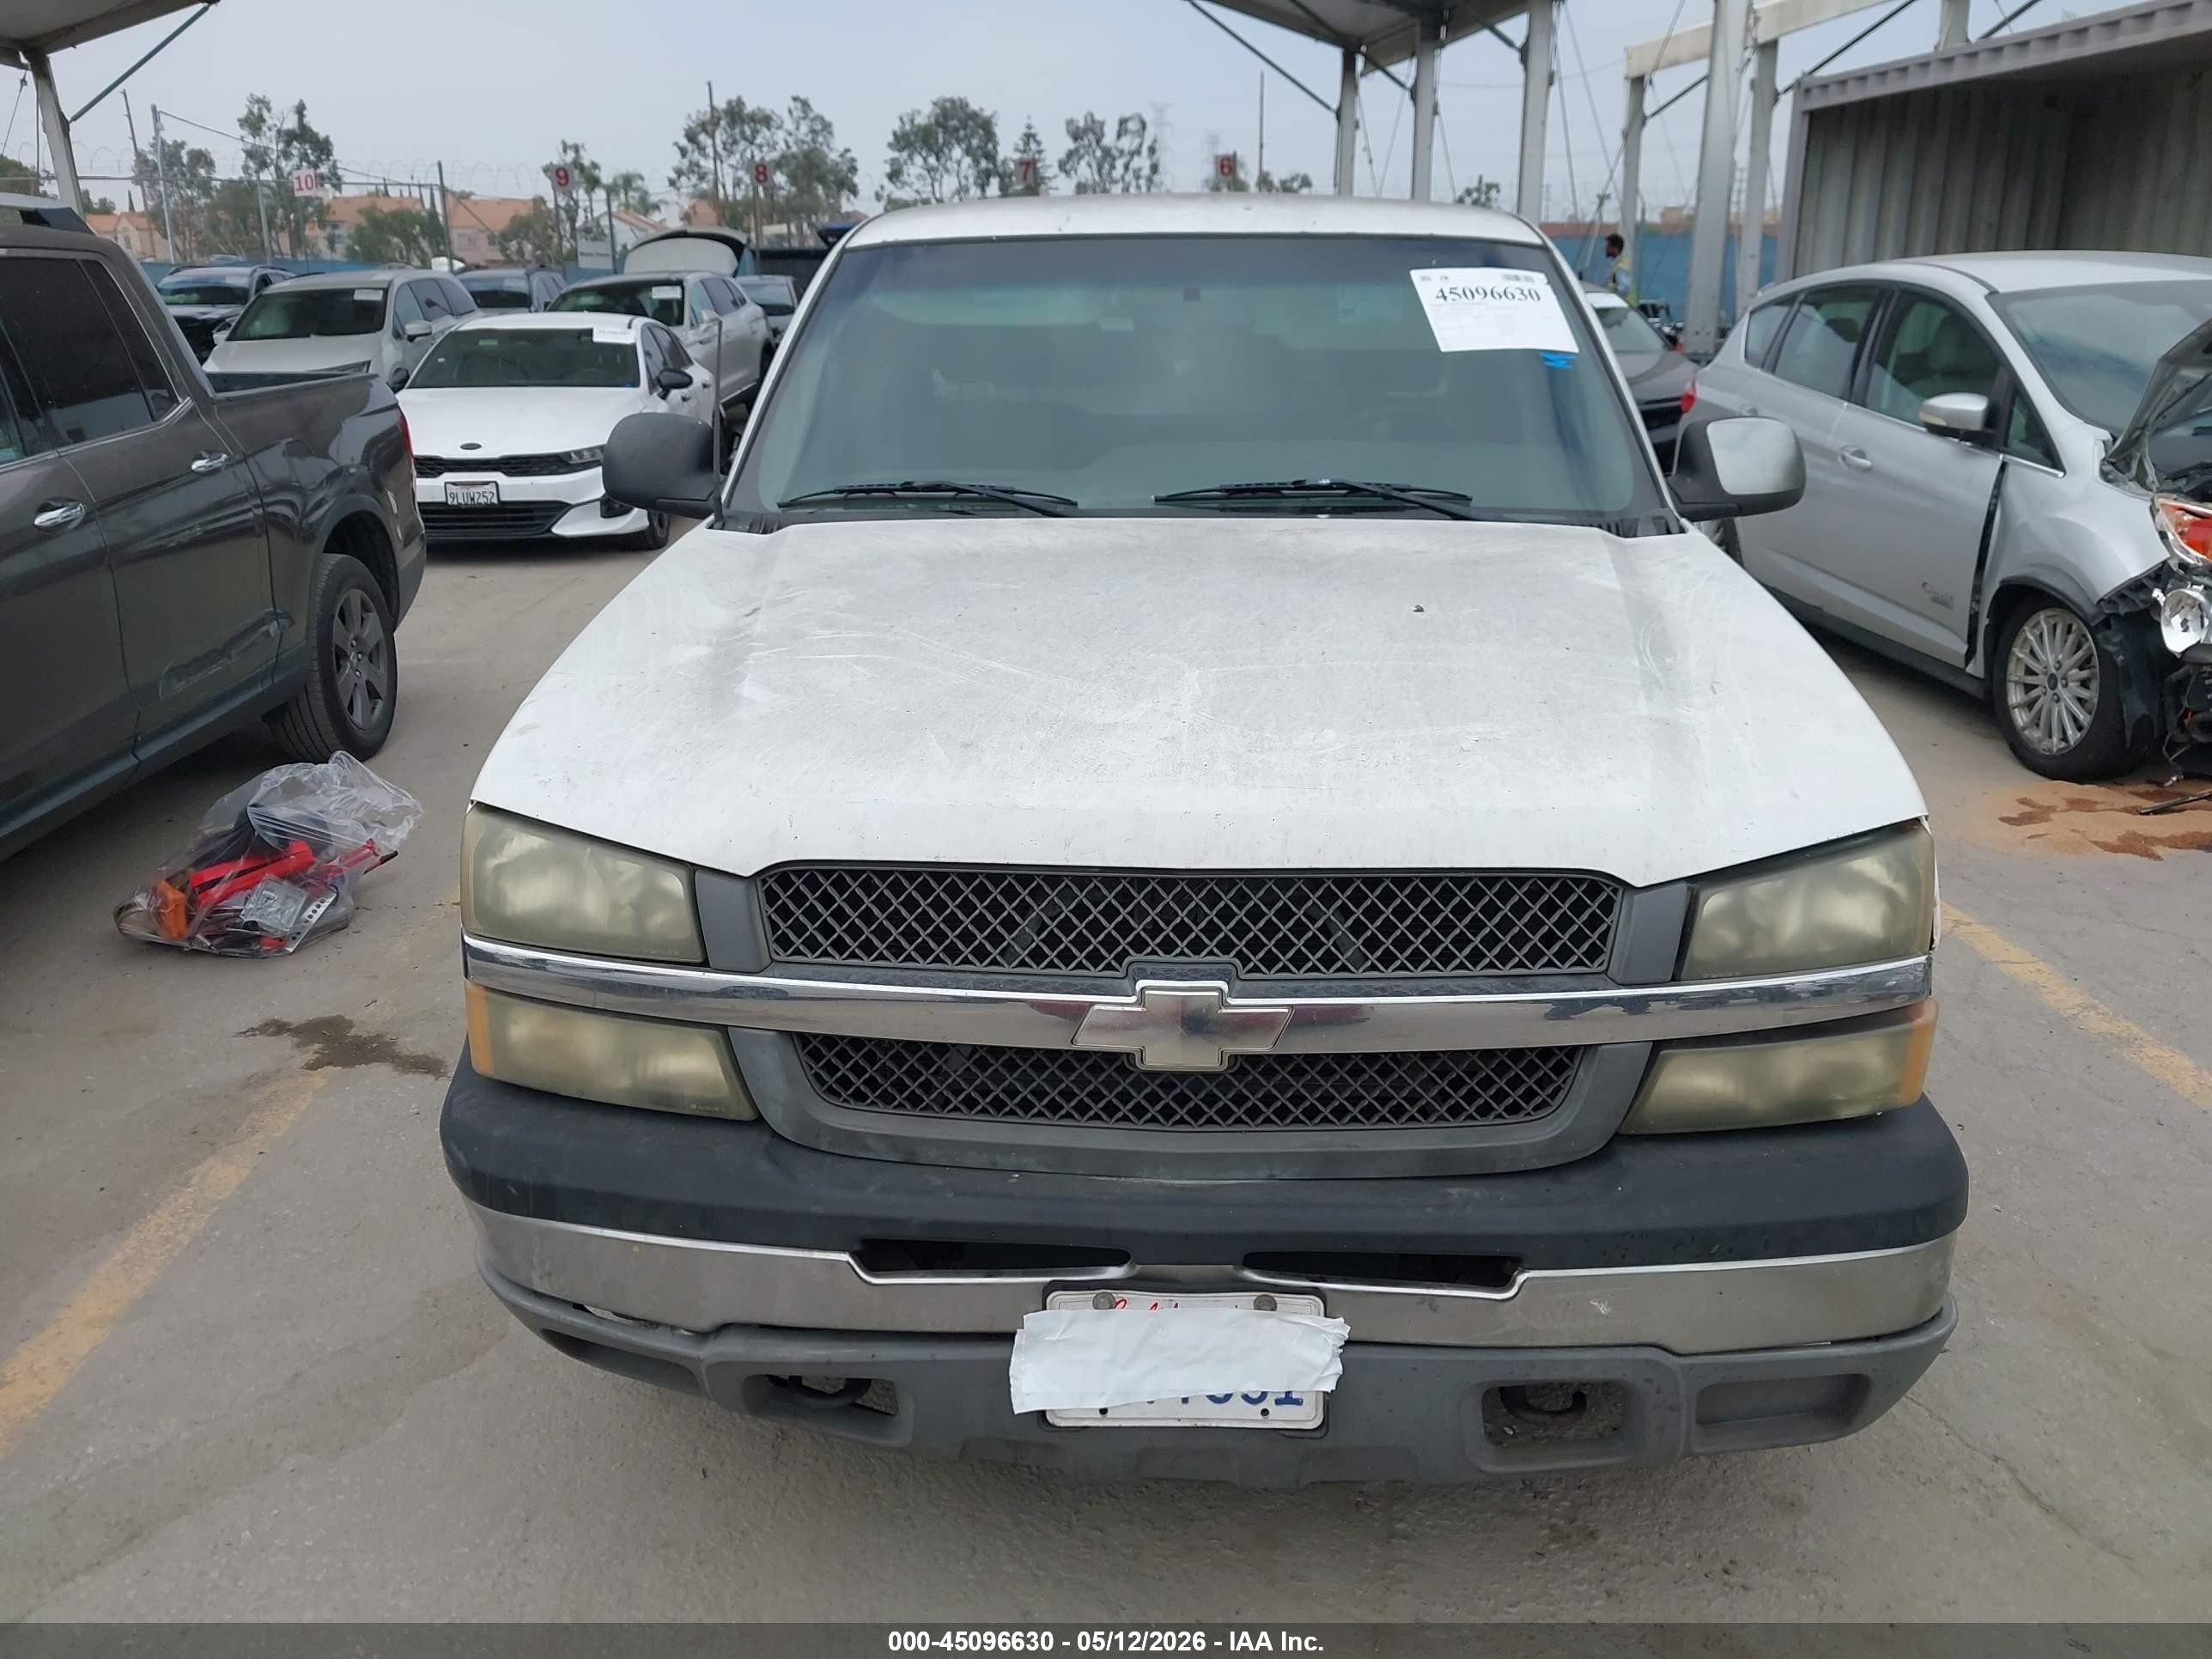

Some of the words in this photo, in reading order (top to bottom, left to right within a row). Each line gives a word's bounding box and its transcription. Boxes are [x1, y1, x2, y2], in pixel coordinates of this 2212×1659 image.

[555, 166, 569, 186] 9
[755, 163, 769, 183] 8
[1019, 161, 1031, 182] 7
[1219, 157, 1232, 177] 6
[295, 174, 314, 191] 10
[1435, 285, 1541, 302] 45096630
